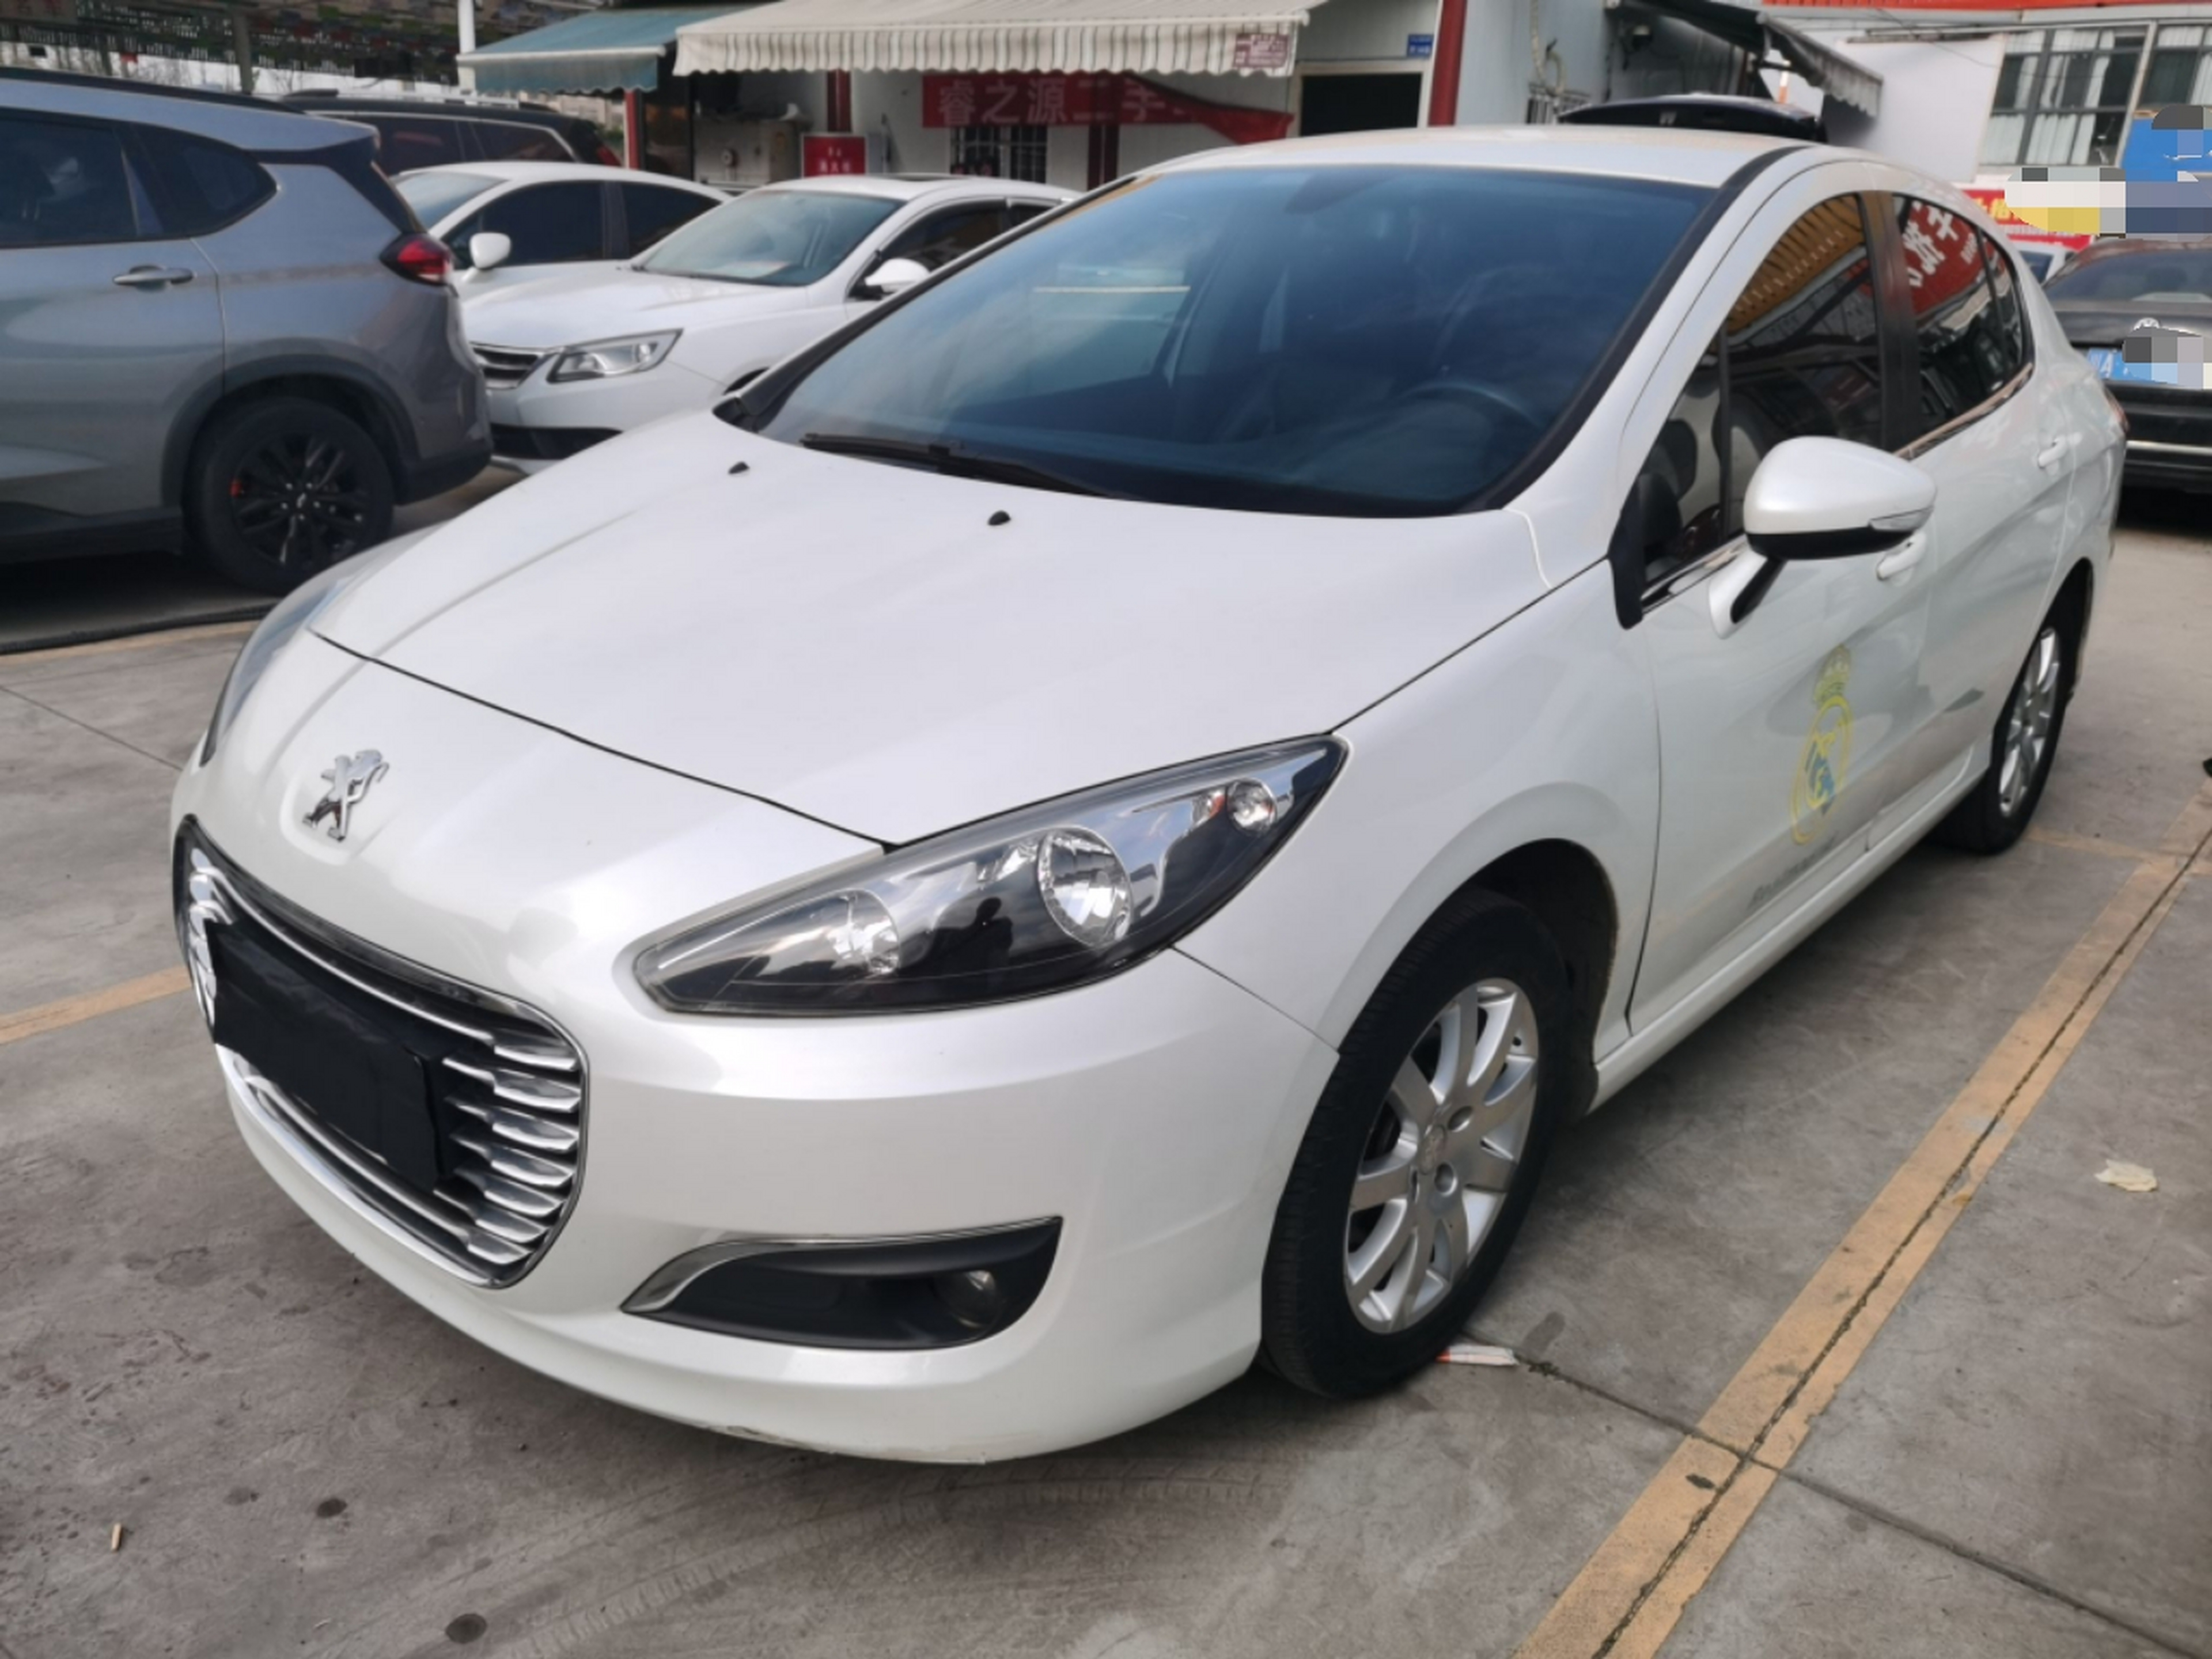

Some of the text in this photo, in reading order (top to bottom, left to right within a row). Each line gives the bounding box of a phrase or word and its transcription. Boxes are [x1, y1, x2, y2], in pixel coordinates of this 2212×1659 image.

[938, 77, 1185, 125] 睿之源二手
